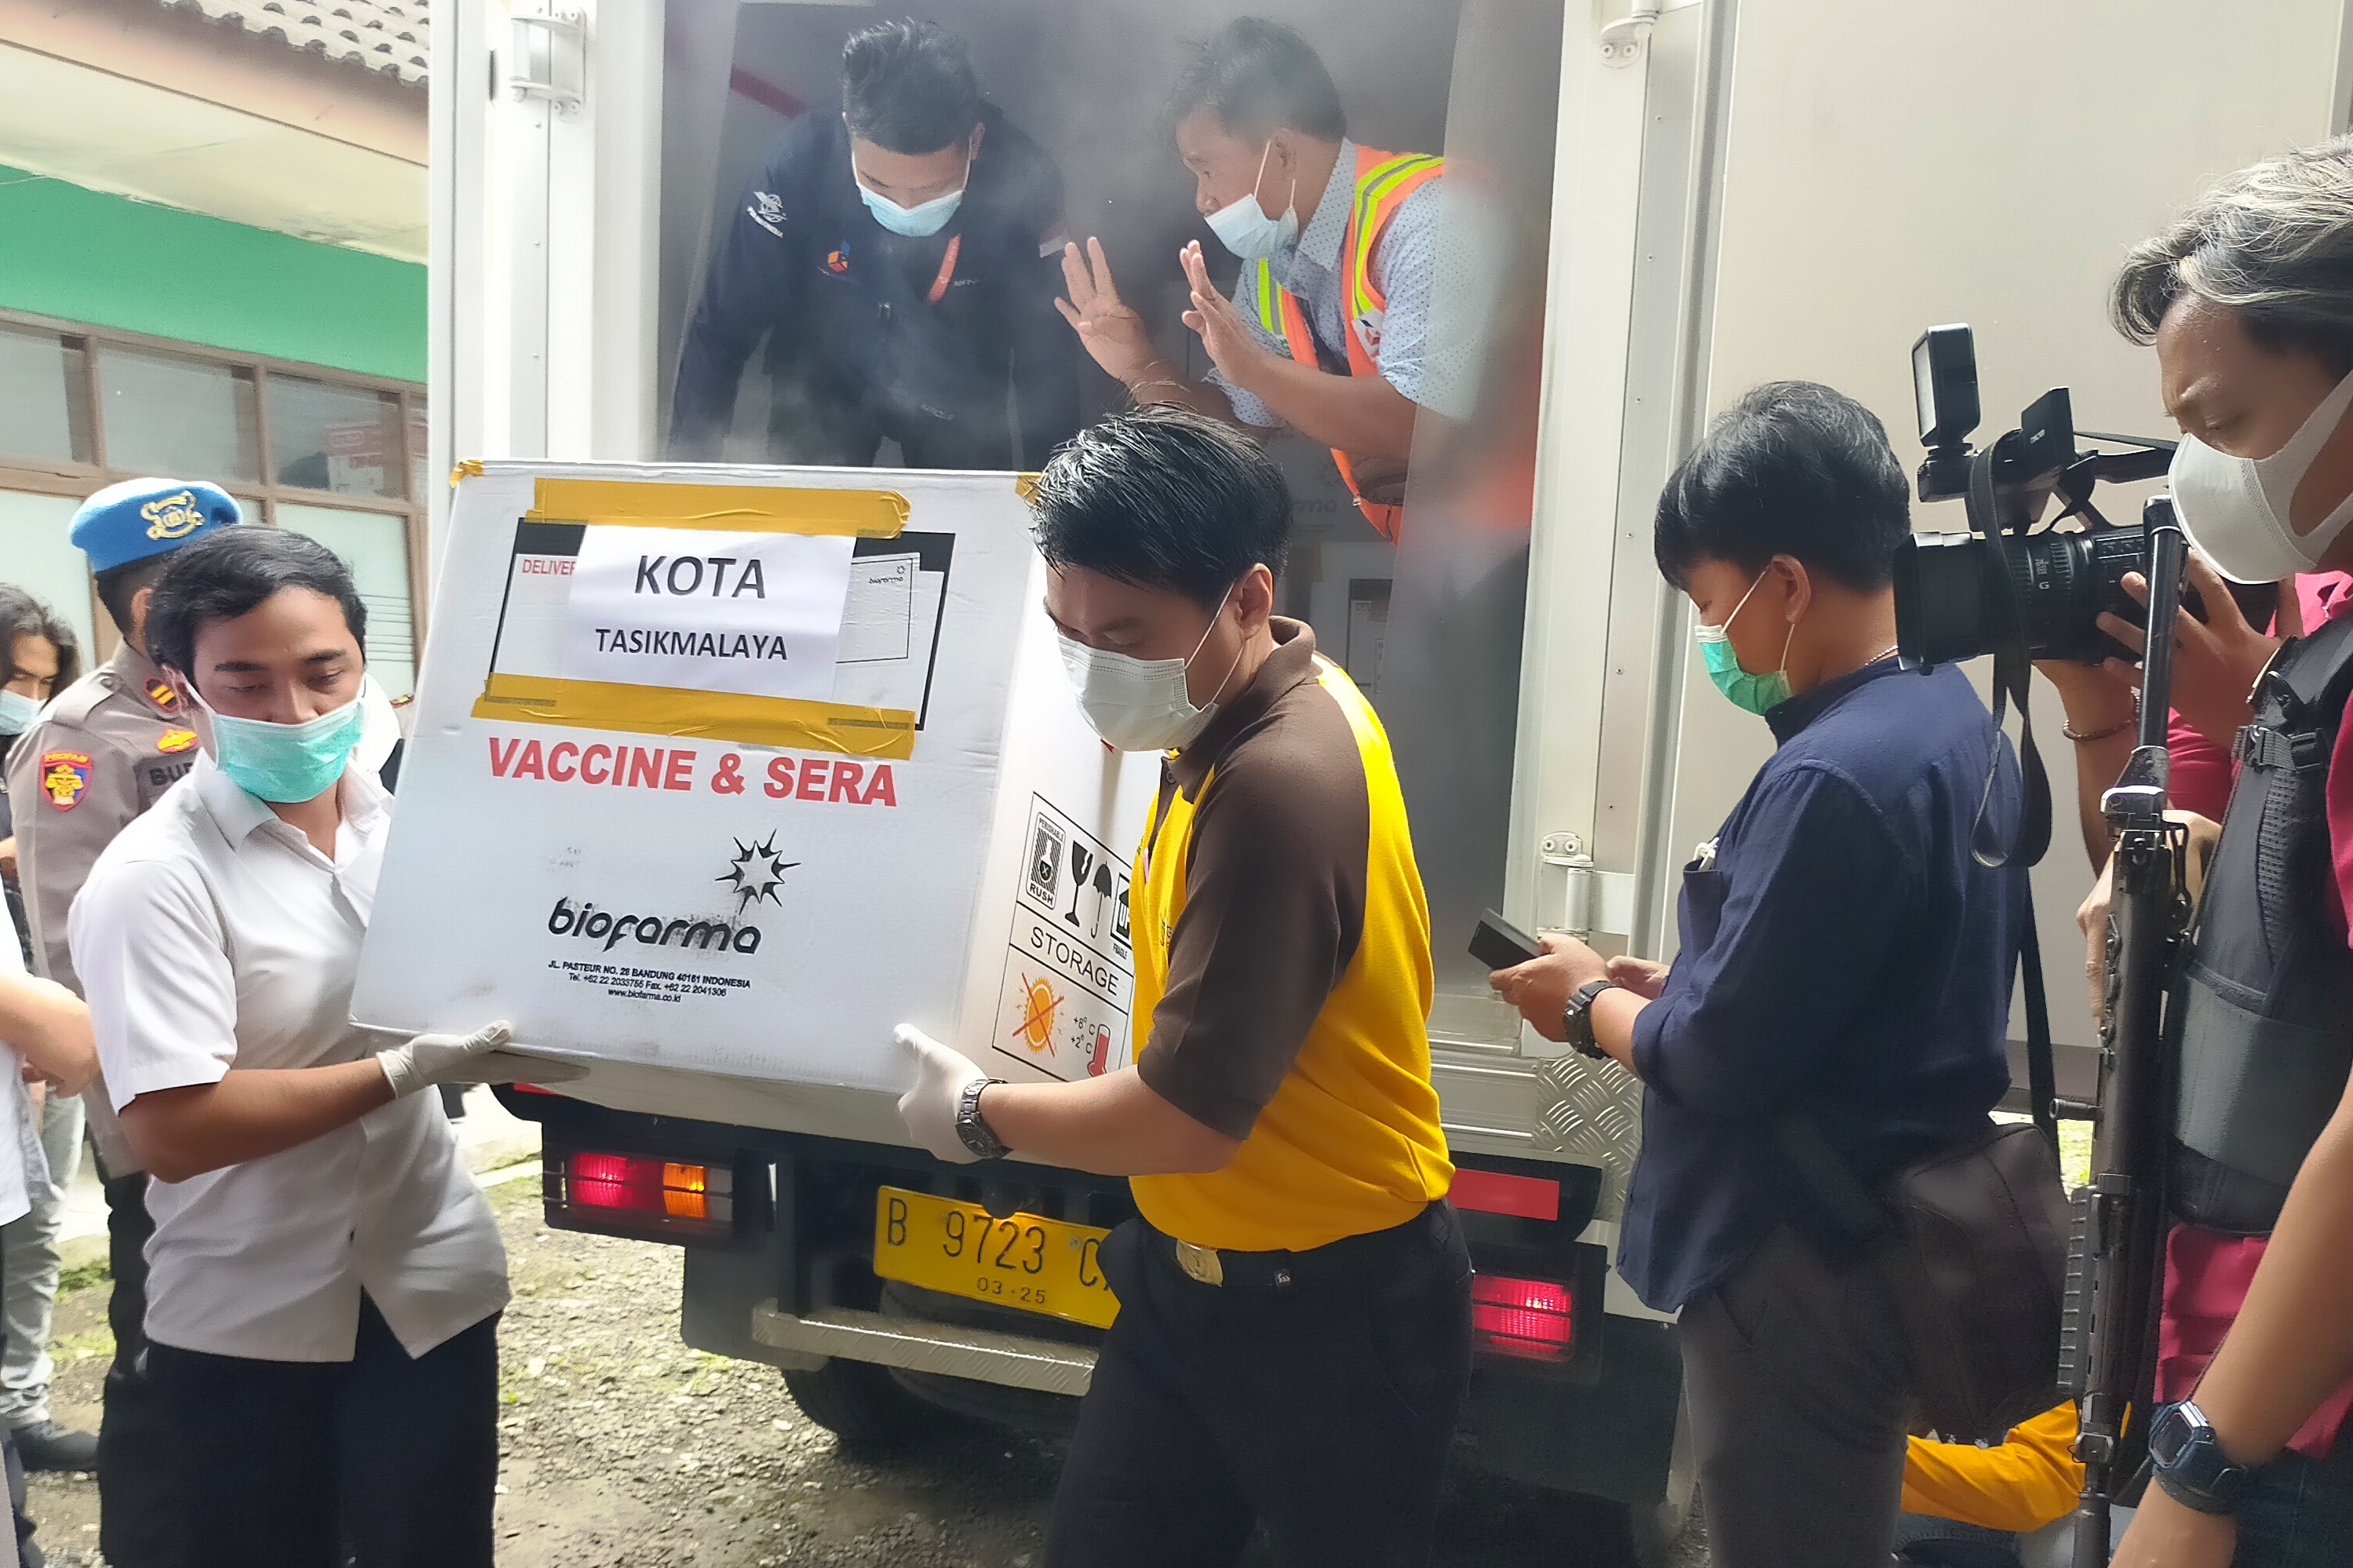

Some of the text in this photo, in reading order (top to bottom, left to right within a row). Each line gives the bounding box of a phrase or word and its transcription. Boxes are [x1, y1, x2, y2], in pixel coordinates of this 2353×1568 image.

[634, 555, 766, 599] KOTA
[595, 628, 788, 660] TASIKMALAYA
[488, 737, 898, 808] VACCINE & SERA
[1029, 882, 1054, 906] RUSH
[548, 896, 762, 954] biofarma
[562, 961, 602, 974] PASTEUR
[603, 965, 618, 975] NO.
[632, 968, 675, 981] BANDUNG
[677, 972, 701, 983] 40161
[702, 975, 751, 989] INDONESIA
[1031, 926, 1119, 997] STORAGE
[600, 975, 610, 985] 22
[664, 983, 679, 992] +62
[680, 983, 691, 993] 22
[608, 989, 682, 1003] www.biofarma.co.id
[888, 1198, 1109, 1292] B 9723 C
